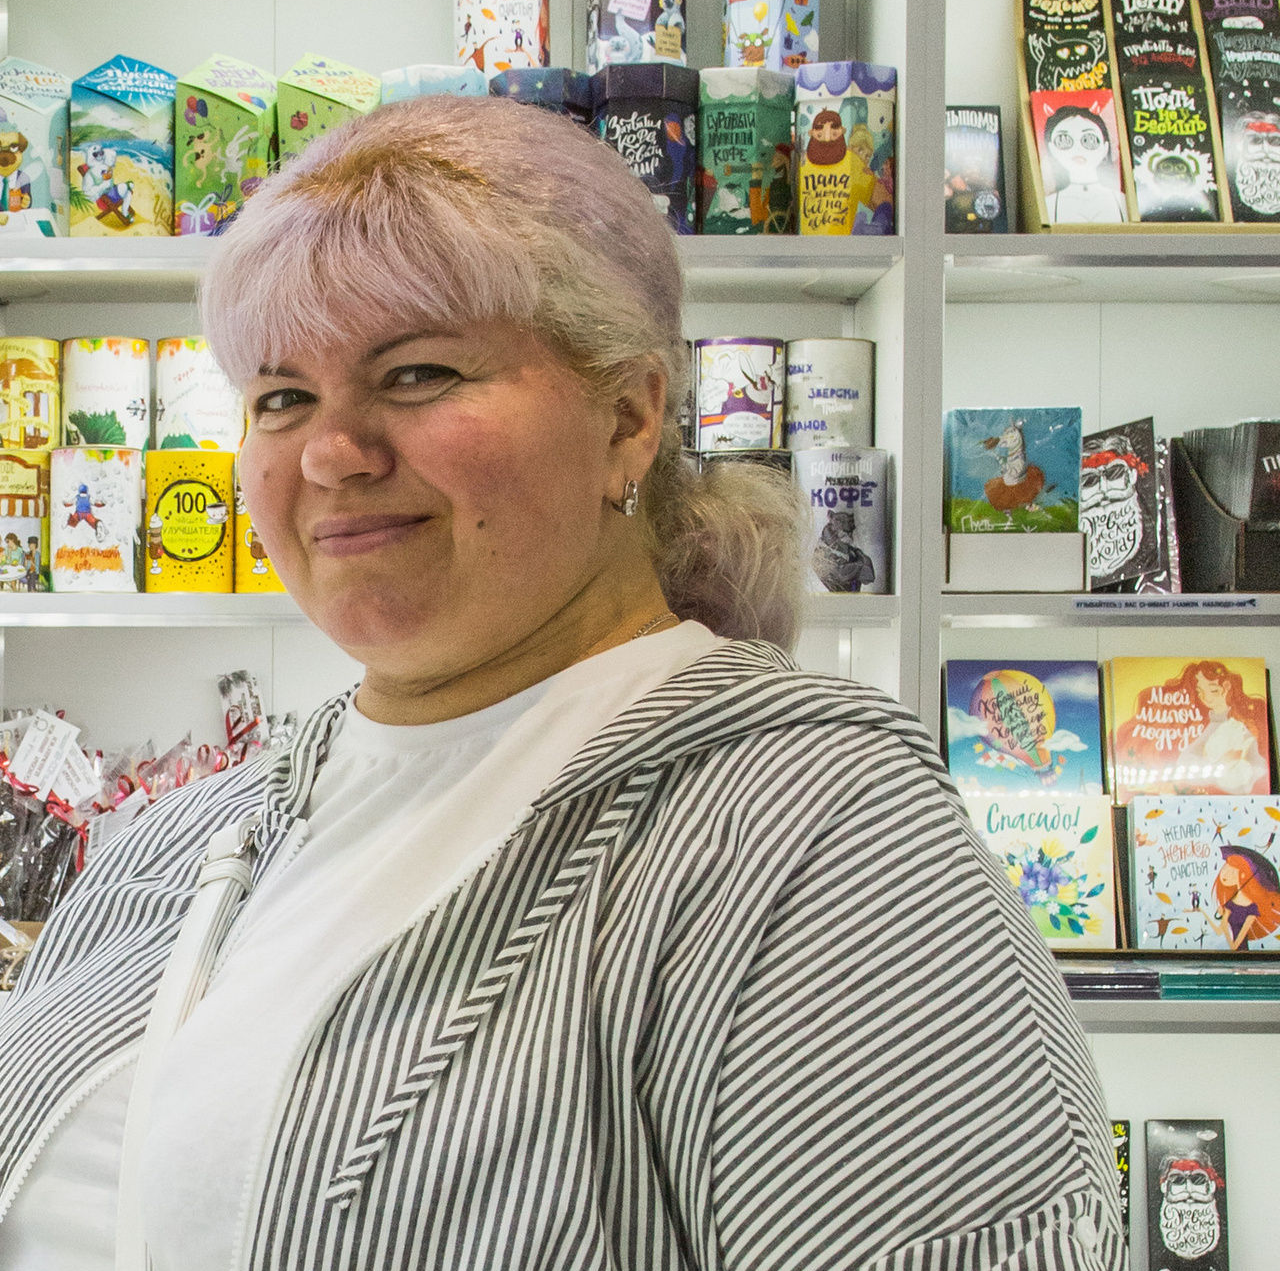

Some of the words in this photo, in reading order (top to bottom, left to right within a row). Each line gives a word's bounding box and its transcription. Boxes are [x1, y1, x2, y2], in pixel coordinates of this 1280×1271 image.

[712, 145, 748, 166] КОФЕ
[174, 492, 206, 514] 100
[811, 487, 873, 508] КОФЕ
[1147, 687, 1190, 706] Моей
[1131, 724, 1205, 752] подруге
[986, 802, 1081, 835] Спасибо!
[1161, 822, 1202, 843] ЖЕЛАЮ
[1170, 861, 1210, 881] СЧАСТЬЯ
